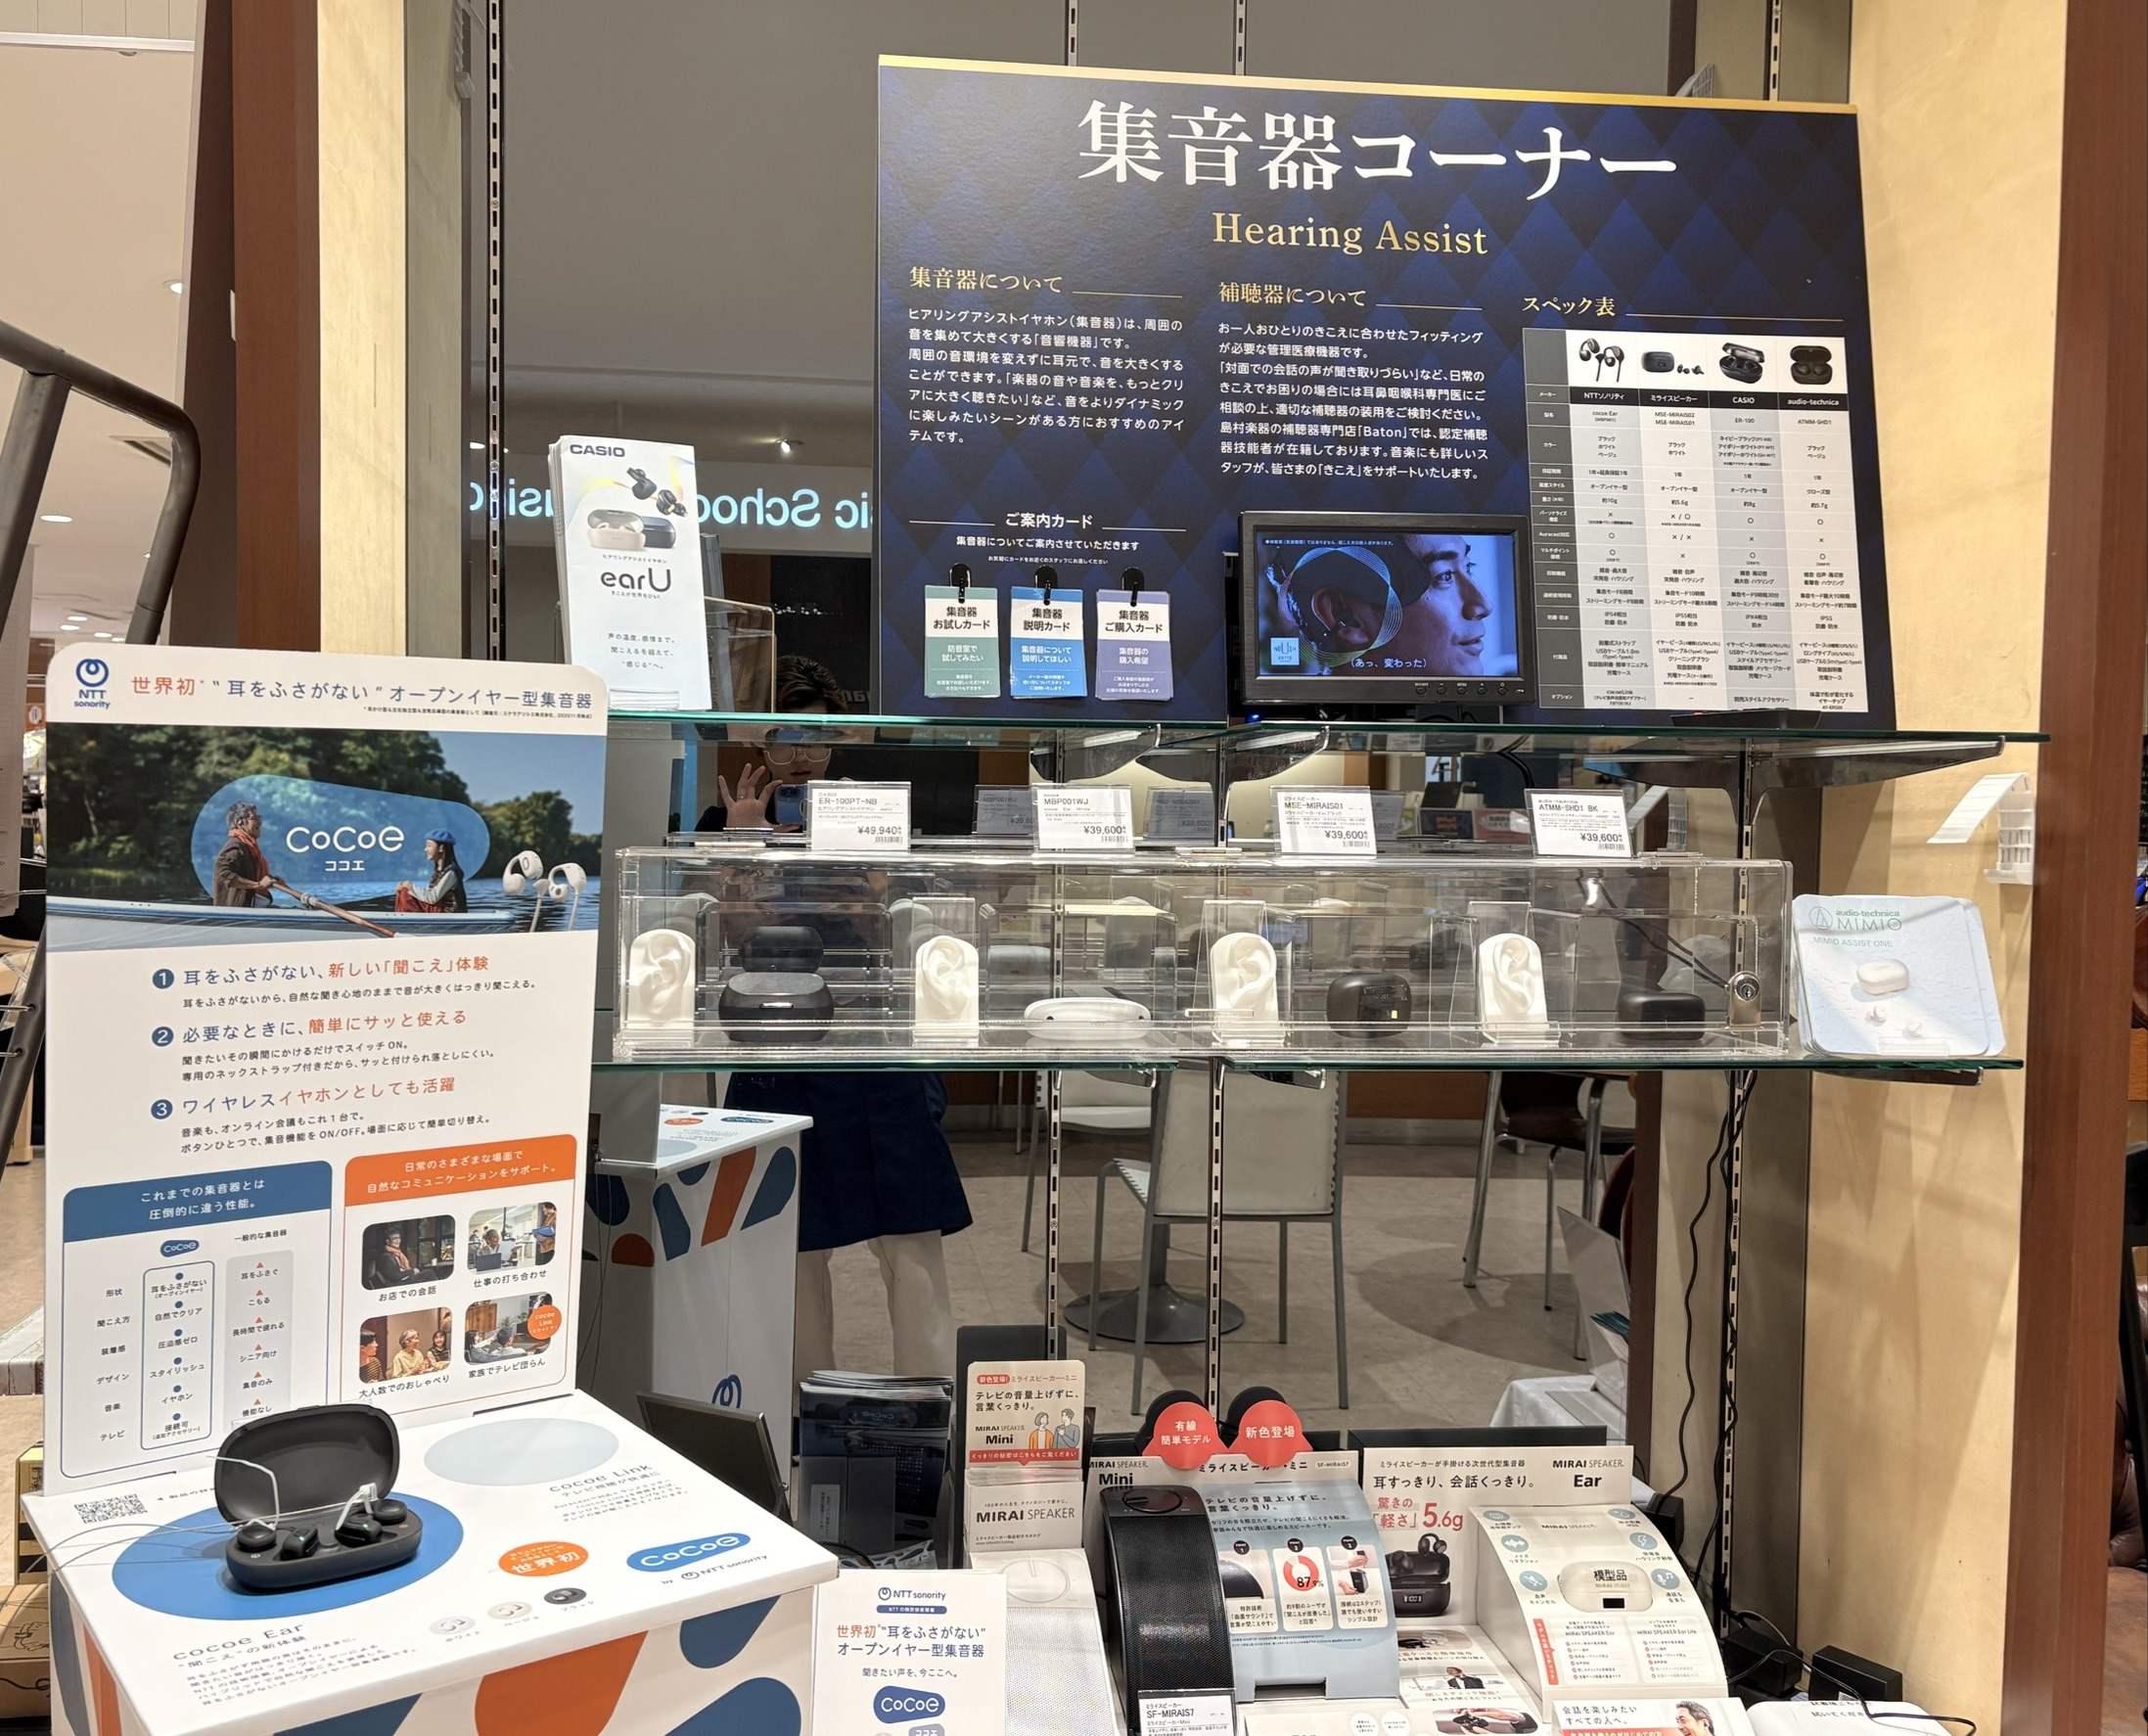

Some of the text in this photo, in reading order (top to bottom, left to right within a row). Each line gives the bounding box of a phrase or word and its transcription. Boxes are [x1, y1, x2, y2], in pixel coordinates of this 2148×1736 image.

[1076, 99, 1676, 201] 集音器コーナー
[1211, 211, 1488, 255] Hearing Assist
[908, 265, 1063, 293] 集音器について
[1218, 282, 1366, 306] 補聴器について
[1522, 296, 1616, 317] スペック表
[908, 430, 964, 443] テムです。
[569, 443, 625, 457] CASIO
[1005, 512, 1093, 528] ご案内カード
[600, 568, 671, 592] earU
[945, 606, 978, 617] 集音器
[1031, 608, 1063, 618] 集音器
[1119, 610, 1150, 620] 集音器
[933, 618, 990, 630] お試しカード
[1023, 619, 1071, 631] 説明カード
[1105, 621, 1164, 633] ご購入カード
[610, 646, 673, 656] 聞こえるを超えて。
[1119, 647, 1149, 656] 集音器の
[941, 654, 983, 662] 試してみたい
[1119, 656, 1149, 664] 購入希望
[77, 688, 107, 699] NTT
[73, 700, 111, 709] sonority
[857, 825, 897, 835] ¥49,940
[1082, 825, 1122, 835] ¥39,600
[1324, 830, 1363, 840] ¥39,600
[1579, 833, 1619, 842] ¥39,600
[324, 859, 366, 872] ココエ
[1837, 917, 1901, 931] MIMIO
[140, 1179, 264, 1203] これまでの集音器とは
[149, 1198, 256, 1220] 圧倒的に違う性能。
[233, 1228, 287, 1242] 一般的な集音器
[241, 1267, 279, 1280] 耳をふさぐ
[473, 1269, 547, 1288] 仕事の打ち合わせ
[151, 1277, 206, 1294] 耳をふさがない
[105, 1287, 122, 1298] 形状
[378, 1285, 436, 1302] お店での会話
[248, 1297, 270, 1305] こもる
[154, 1307, 202, 1321] 自然でクリア
[96, 1315, 130, 1327] 聞こえ方
[232, 1321, 285, 1337] 長時間で疲れる
[100, 1345, 126, 1355] 装着感
[239, 1349, 277, 1363] シニア向け
[150, 1363, 205, 1378] スタイリッシュ
[468, 1357, 545, 1379] 家族でテレビ団らん
[96, 1373, 129, 1385] デザイン
[242, 1377, 273, 1390] 集音のみ
[160, 1393, 194, 1404] イヤホン
[104, 1402, 121, 1412] 音楽
[242, 1404, 272, 1417] 機能なし
[975, 1401, 1034, 1412] 言葉くっきり。
[164, 1420, 189, 1432] 接続可
[1174, 1419, 1197, 1433] 有線
[1245, 1425, 1296, 1439] 新色登場
[100, 1430, 125, 1441] テレビ
[985, 1434, 1013, 1444] Mini
[1161, 1434, 1211, 1446] 簡単モデル
[1552, 1459, 1587, 1468] MIRAI
[549, 1463, 653, 1492] cocoe Link
[1098, 1473, 1133, 1485] Mini
[1373, 1474, 1602, 1489] 耳すっきり、会話くっきり。 Ear
[1208, 1504, 1277, 1513] 言葉くっきり。
[1377, 1496, 1412, 1509] 驚きの
[976, 1507, 1074, 1523] MIRAI SPEAKER
[1372, 1512, 1417, 1529] 「軽さ」
[1422, 1501, 1463, 1531] 5.6g
[511, 1551, 580, 1574] 世界初
[700, 1565, 725, 1576] NTT
[726, 1554, 768, 1568] sonority
[1593, 1569, 1627, 1581] 模型品
[892, 1589, 946, 1601] NTT sonority
[172, 1623, 304, 1661] cocoe Ear
[837, 1642, 984, 1658] オープンイヤー型集音器
[1146, 1708, 1194, 1718] SF-MIRAIS7
[1562, 1705, 1637, 1714] 会話を楽しみたい
[1566, 1716, 1627, 1725] すべての人へ。
